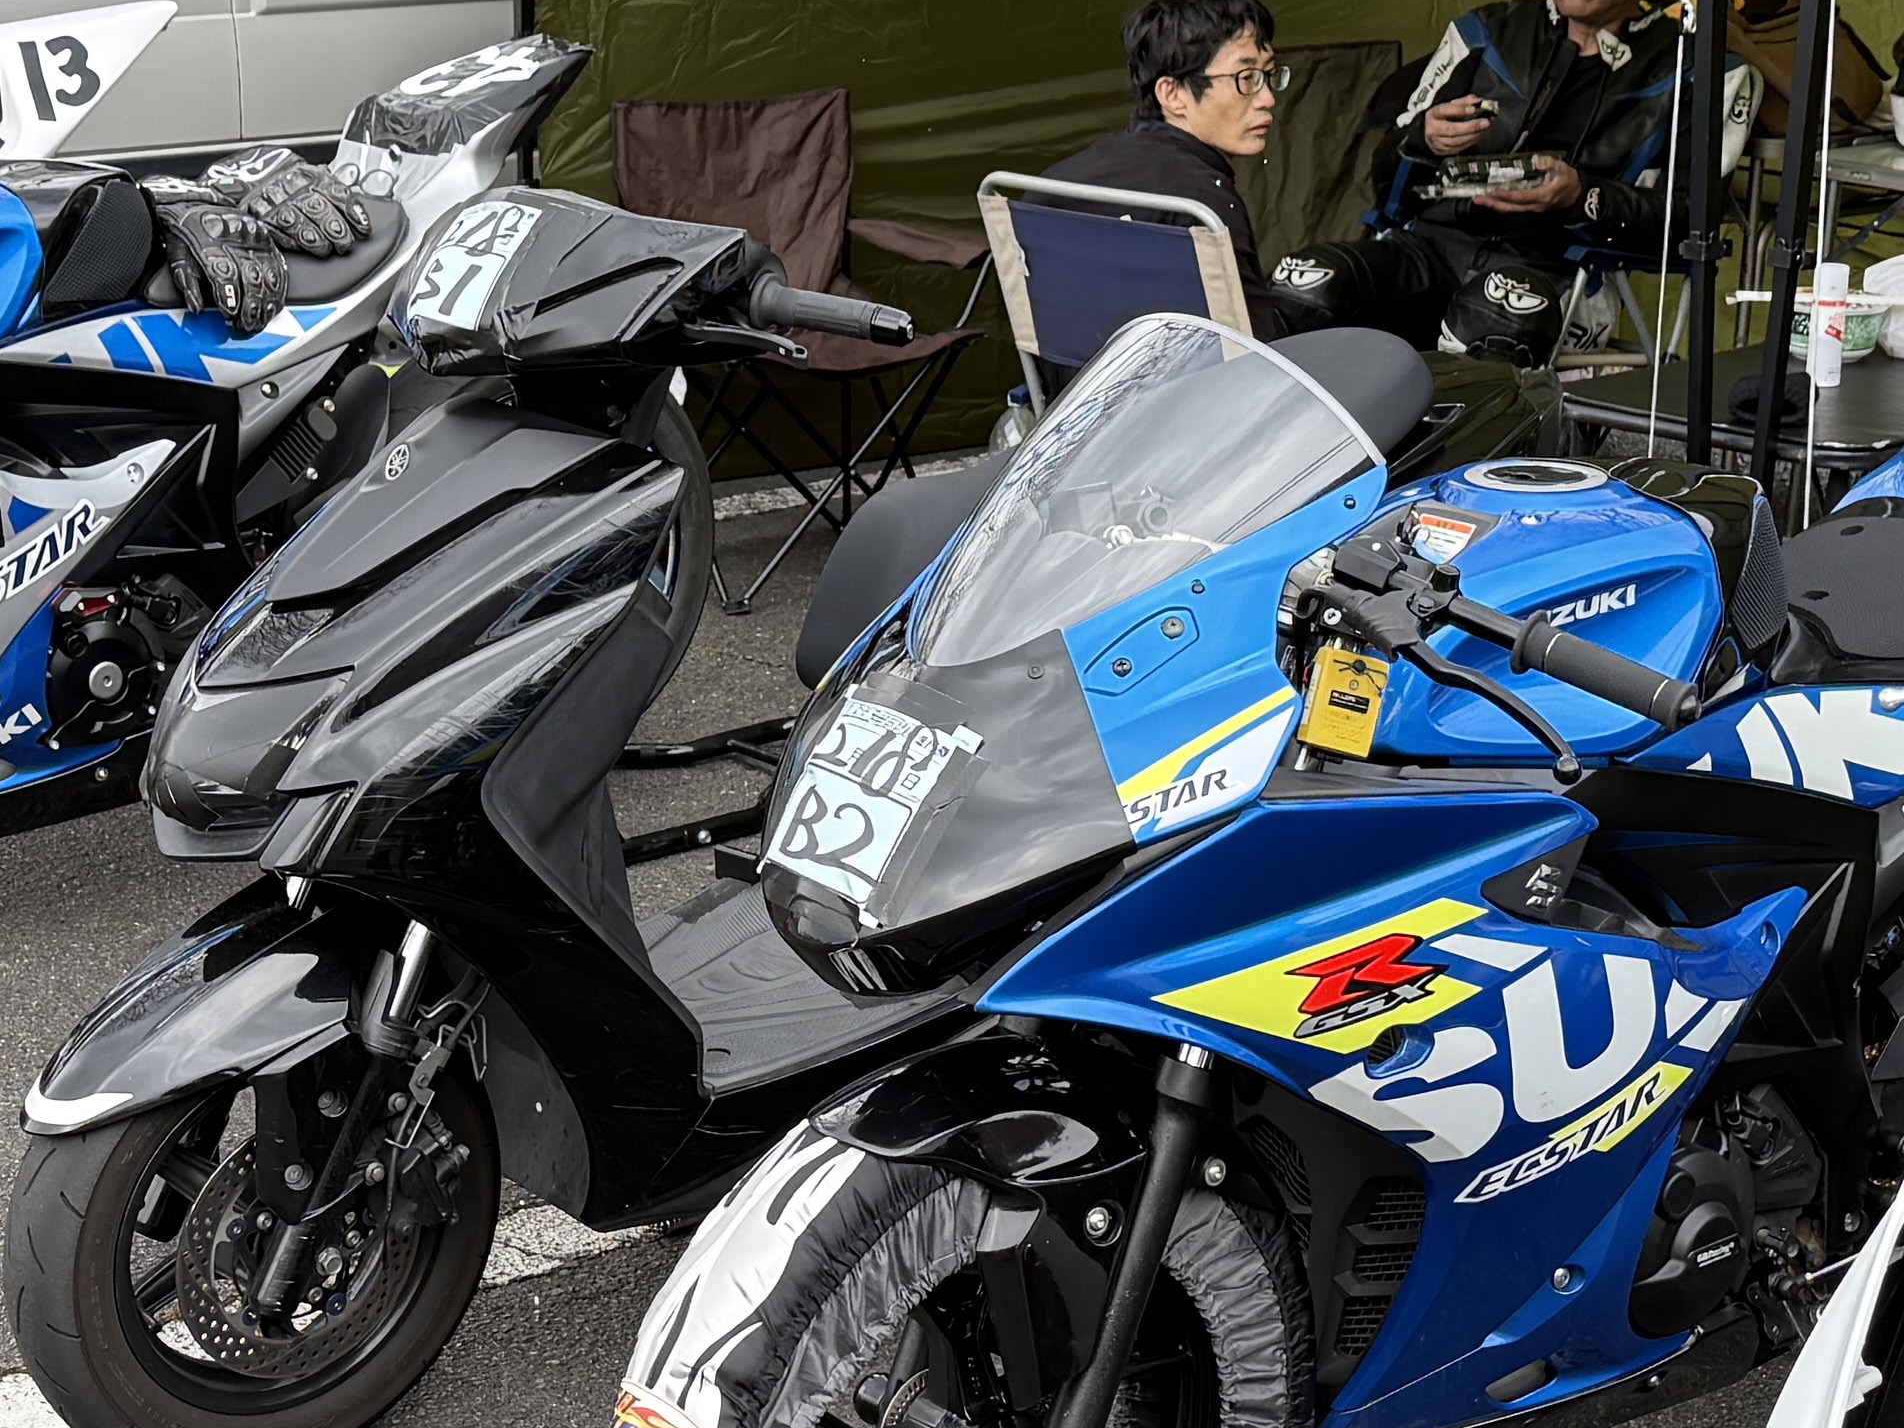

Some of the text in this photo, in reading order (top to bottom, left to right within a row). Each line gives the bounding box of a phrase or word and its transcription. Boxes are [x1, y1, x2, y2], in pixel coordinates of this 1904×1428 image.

[18, 35, 101, 122] 13
[1546, 583, 1636, 628] ZUKI
[1123, 768, 1228, 824] STAR
[779, 784, 880, 886] B2
[1295, 971, 1433, 1038] GSX
[1454, 1069, 1667, 1204] ECSTAR
